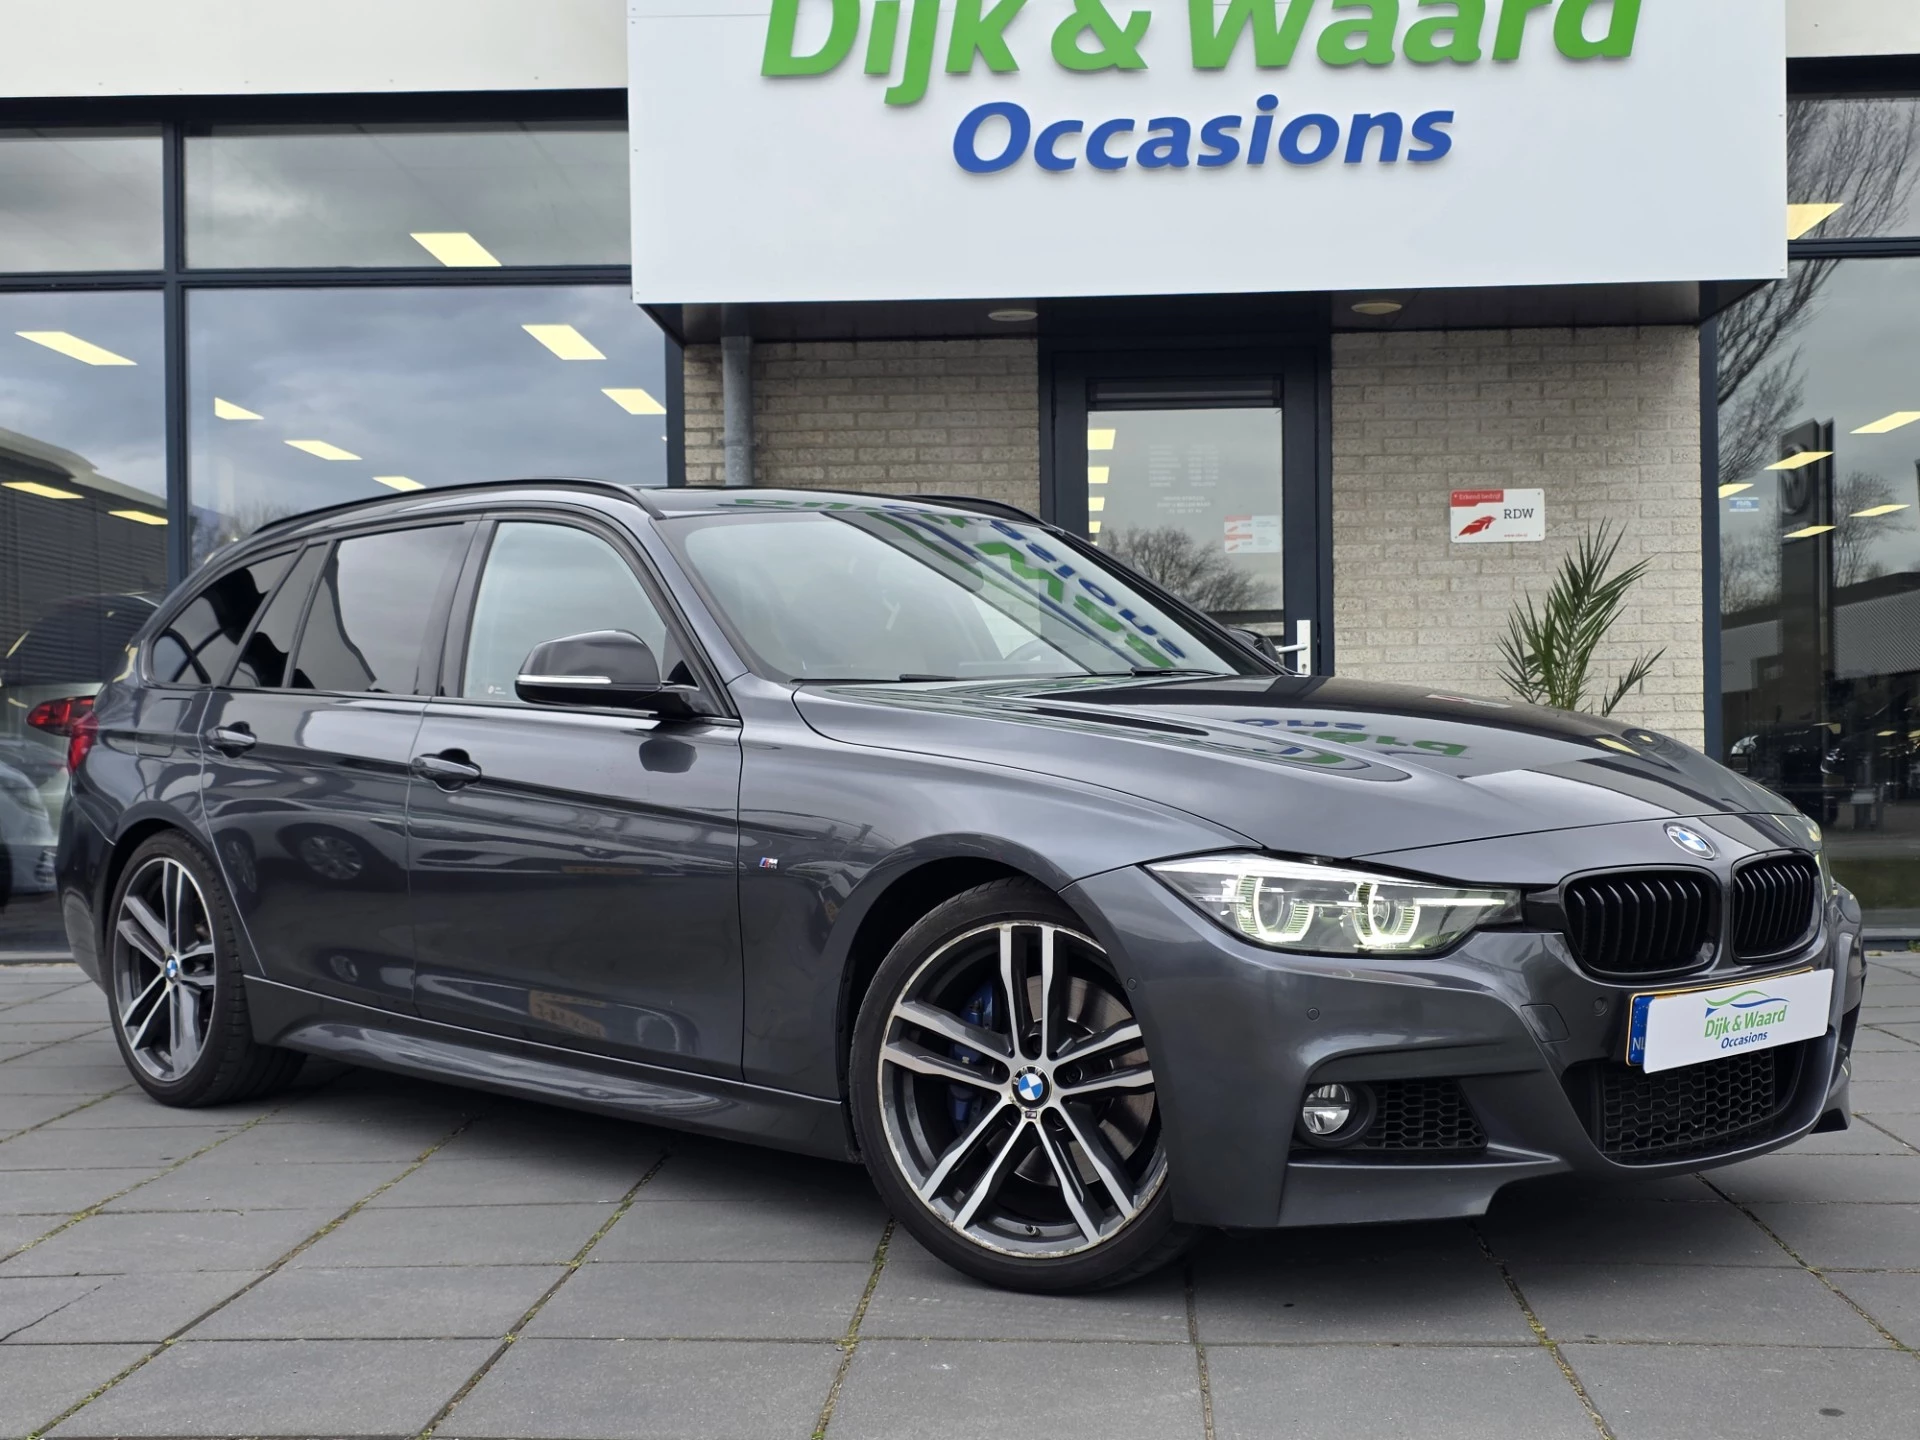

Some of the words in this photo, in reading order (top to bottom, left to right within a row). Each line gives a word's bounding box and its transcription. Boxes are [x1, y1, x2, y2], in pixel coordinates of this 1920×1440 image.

[762, 0, 1025, 105] Dijk
[1052, 0, 1150, 72] &
[1188, 0, 1642, 69] Waard
[953, 94, 1455, 174] Occasions
[1503, 508, 1533, 519] RDW
[1704, 1017, 1730, 1041] Dijk
[1732, 1015, 1742, 1032] &
[1744, 1006, 1786, 1028] Waard
[1720, 1031, 1768, 1049] Occasions
